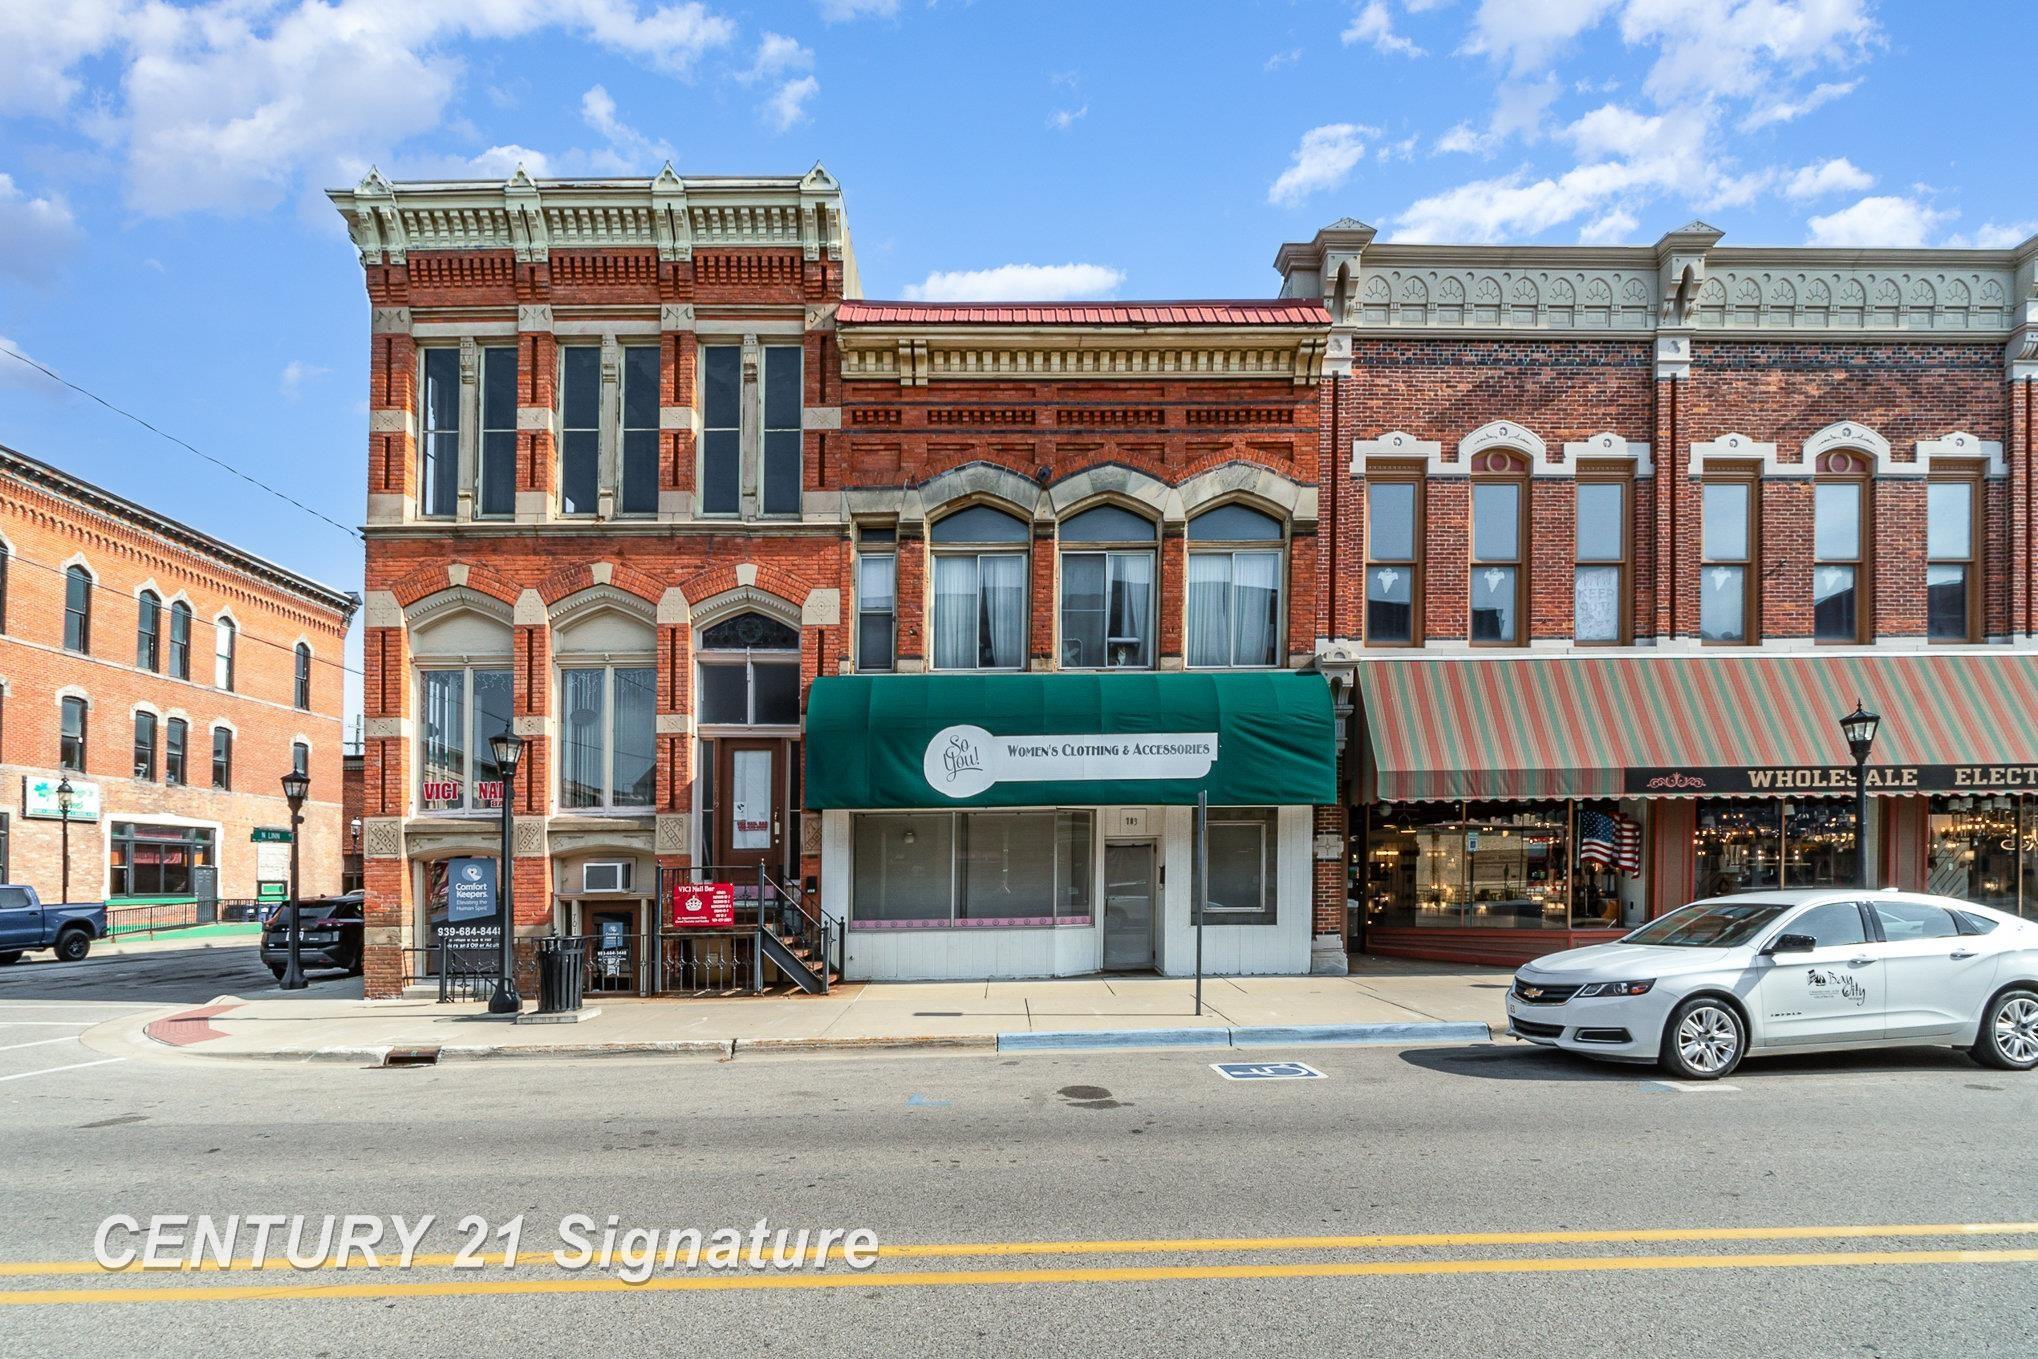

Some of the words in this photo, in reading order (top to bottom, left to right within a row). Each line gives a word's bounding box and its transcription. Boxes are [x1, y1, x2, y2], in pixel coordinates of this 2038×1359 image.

[946, 734, 969, 756] So
[1061, 743, 1119, 756] CLOTHING
[1122, 745, 1130, 755] &
[1133, 742, 1210, 756] ACCESSORIES
[1954, 767, 2038, 786] ELECT
[423, 782, 459, 801] VICI
[478, 782, 504, 800] NAI
[267, 831, 281, 840] LINN
[455, 882, 488, 891] Comfort
[1828, 970, 1853, 986] Bay
[1842, 983, 1866, 1007] City
